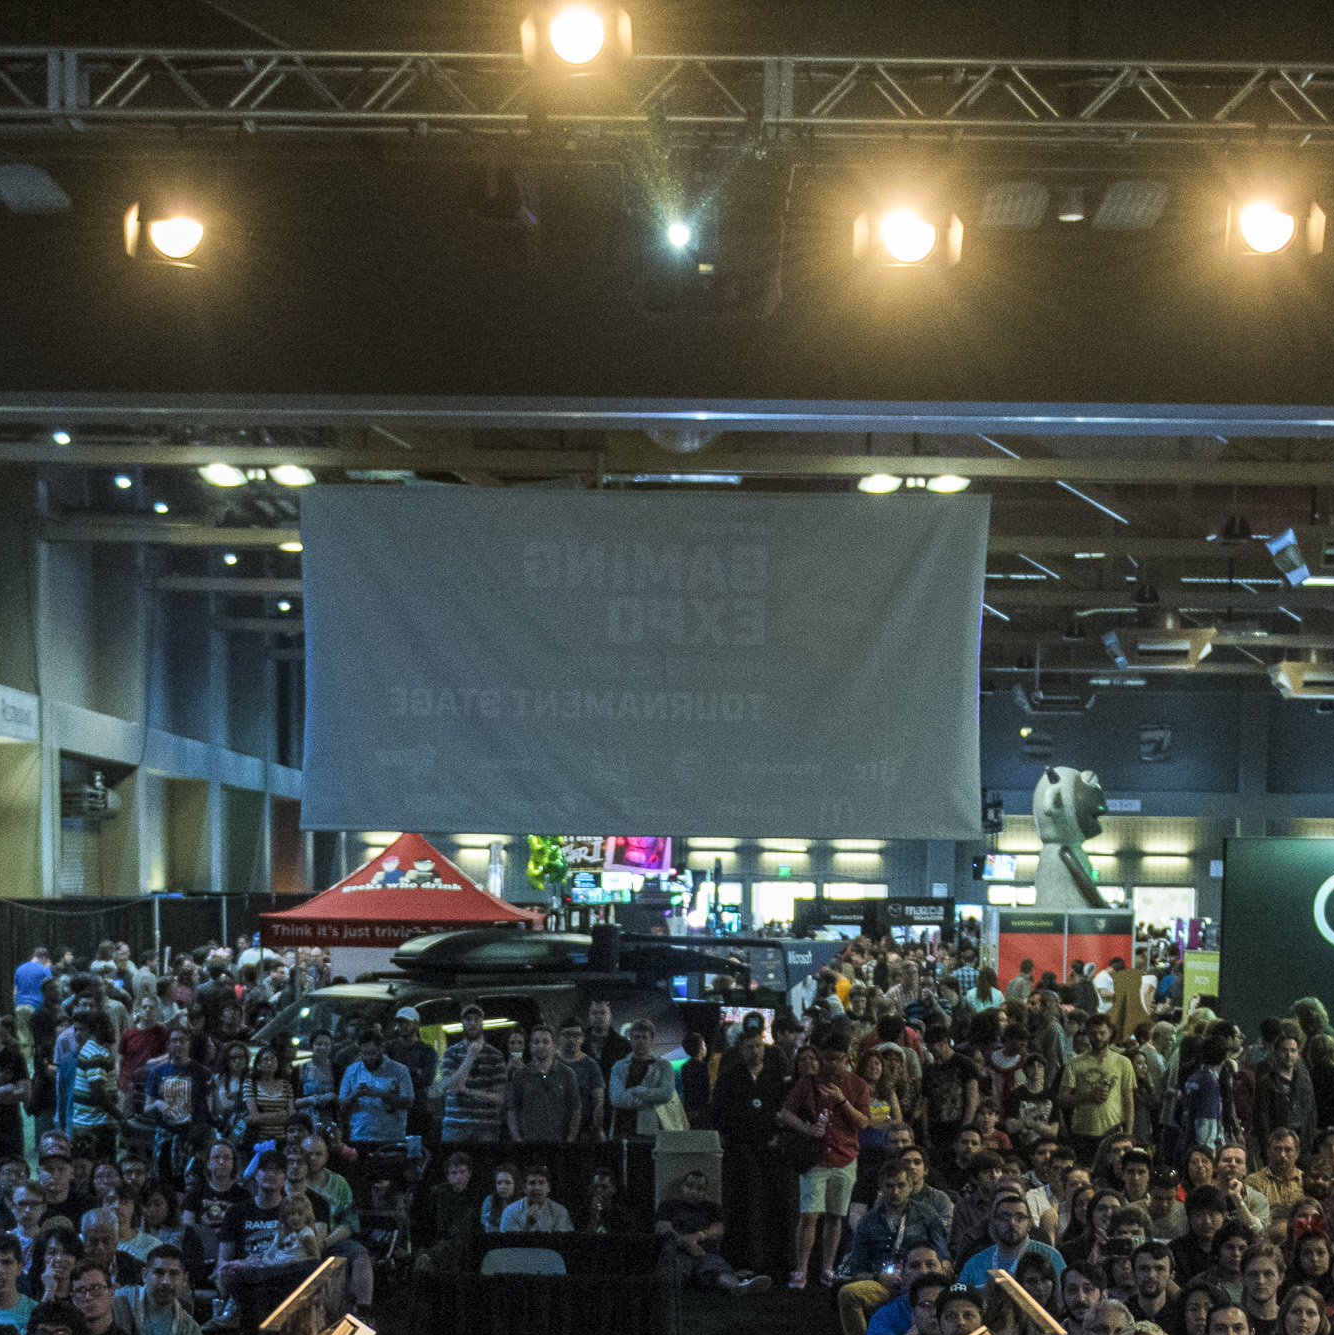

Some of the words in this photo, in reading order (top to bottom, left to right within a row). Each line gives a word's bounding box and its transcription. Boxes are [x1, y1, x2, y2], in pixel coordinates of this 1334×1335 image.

[386, 878, 418, 889] who
[421, 877, 462, 890] drink
[272, 923, 313, 937] Think
[317, 924, 339, 937] it's
[343, 926, 370, 939] just
